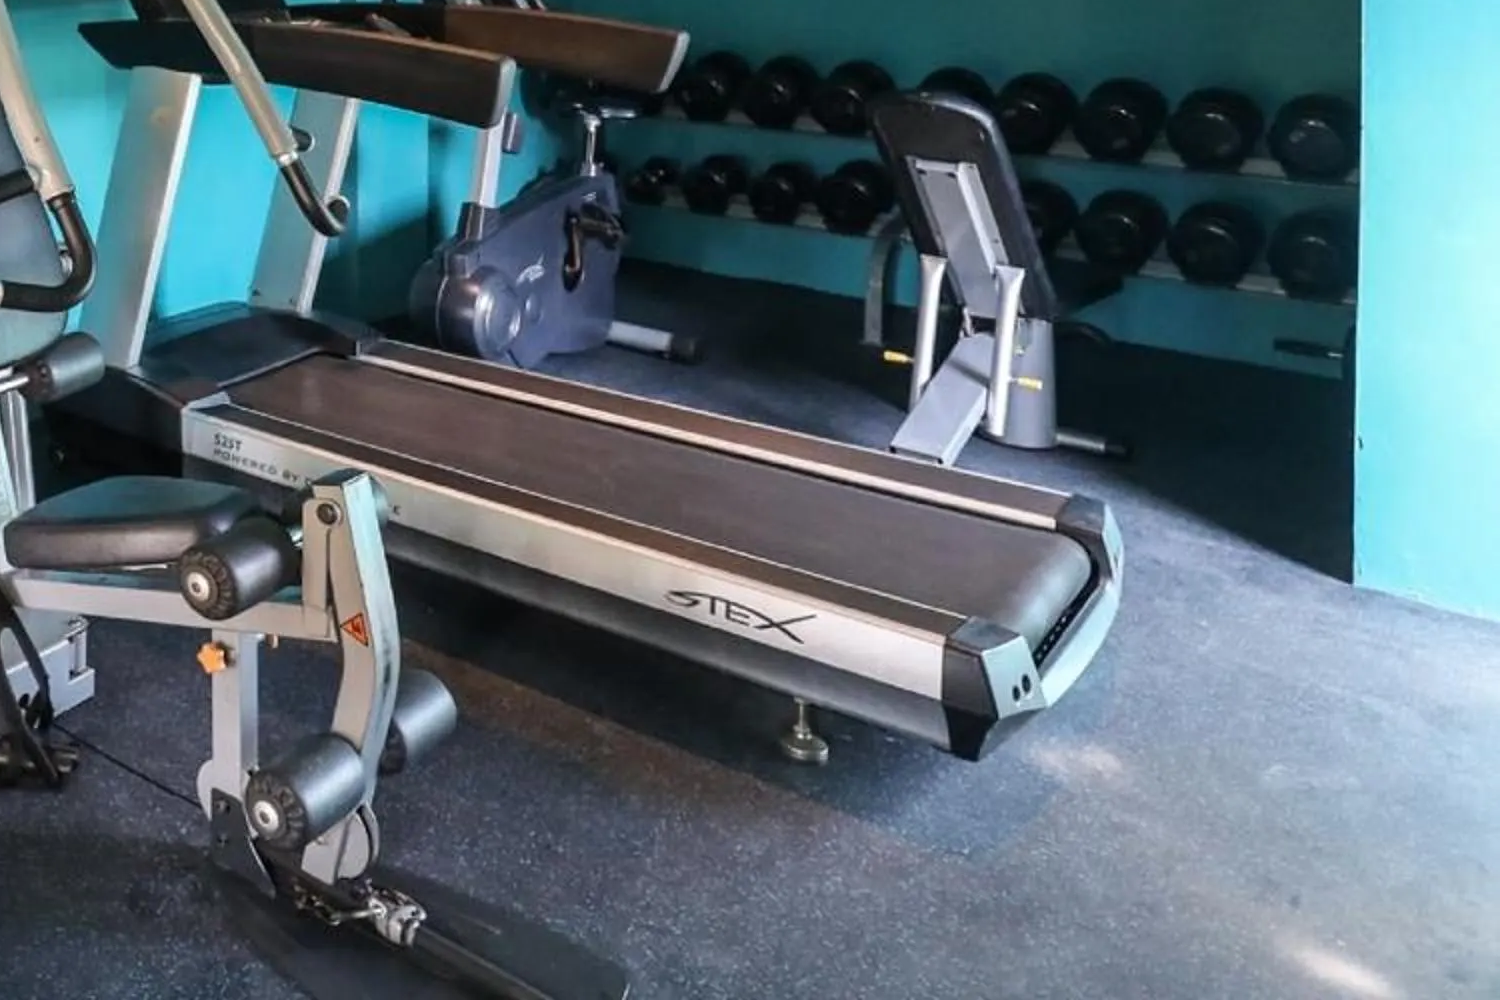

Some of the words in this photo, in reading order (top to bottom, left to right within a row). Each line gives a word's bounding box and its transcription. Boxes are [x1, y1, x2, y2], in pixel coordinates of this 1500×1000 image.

[213, 447, 278, 475] POWERED
[282, 469, 300, 484] BY
[664, 590, 818, 645] STEX
